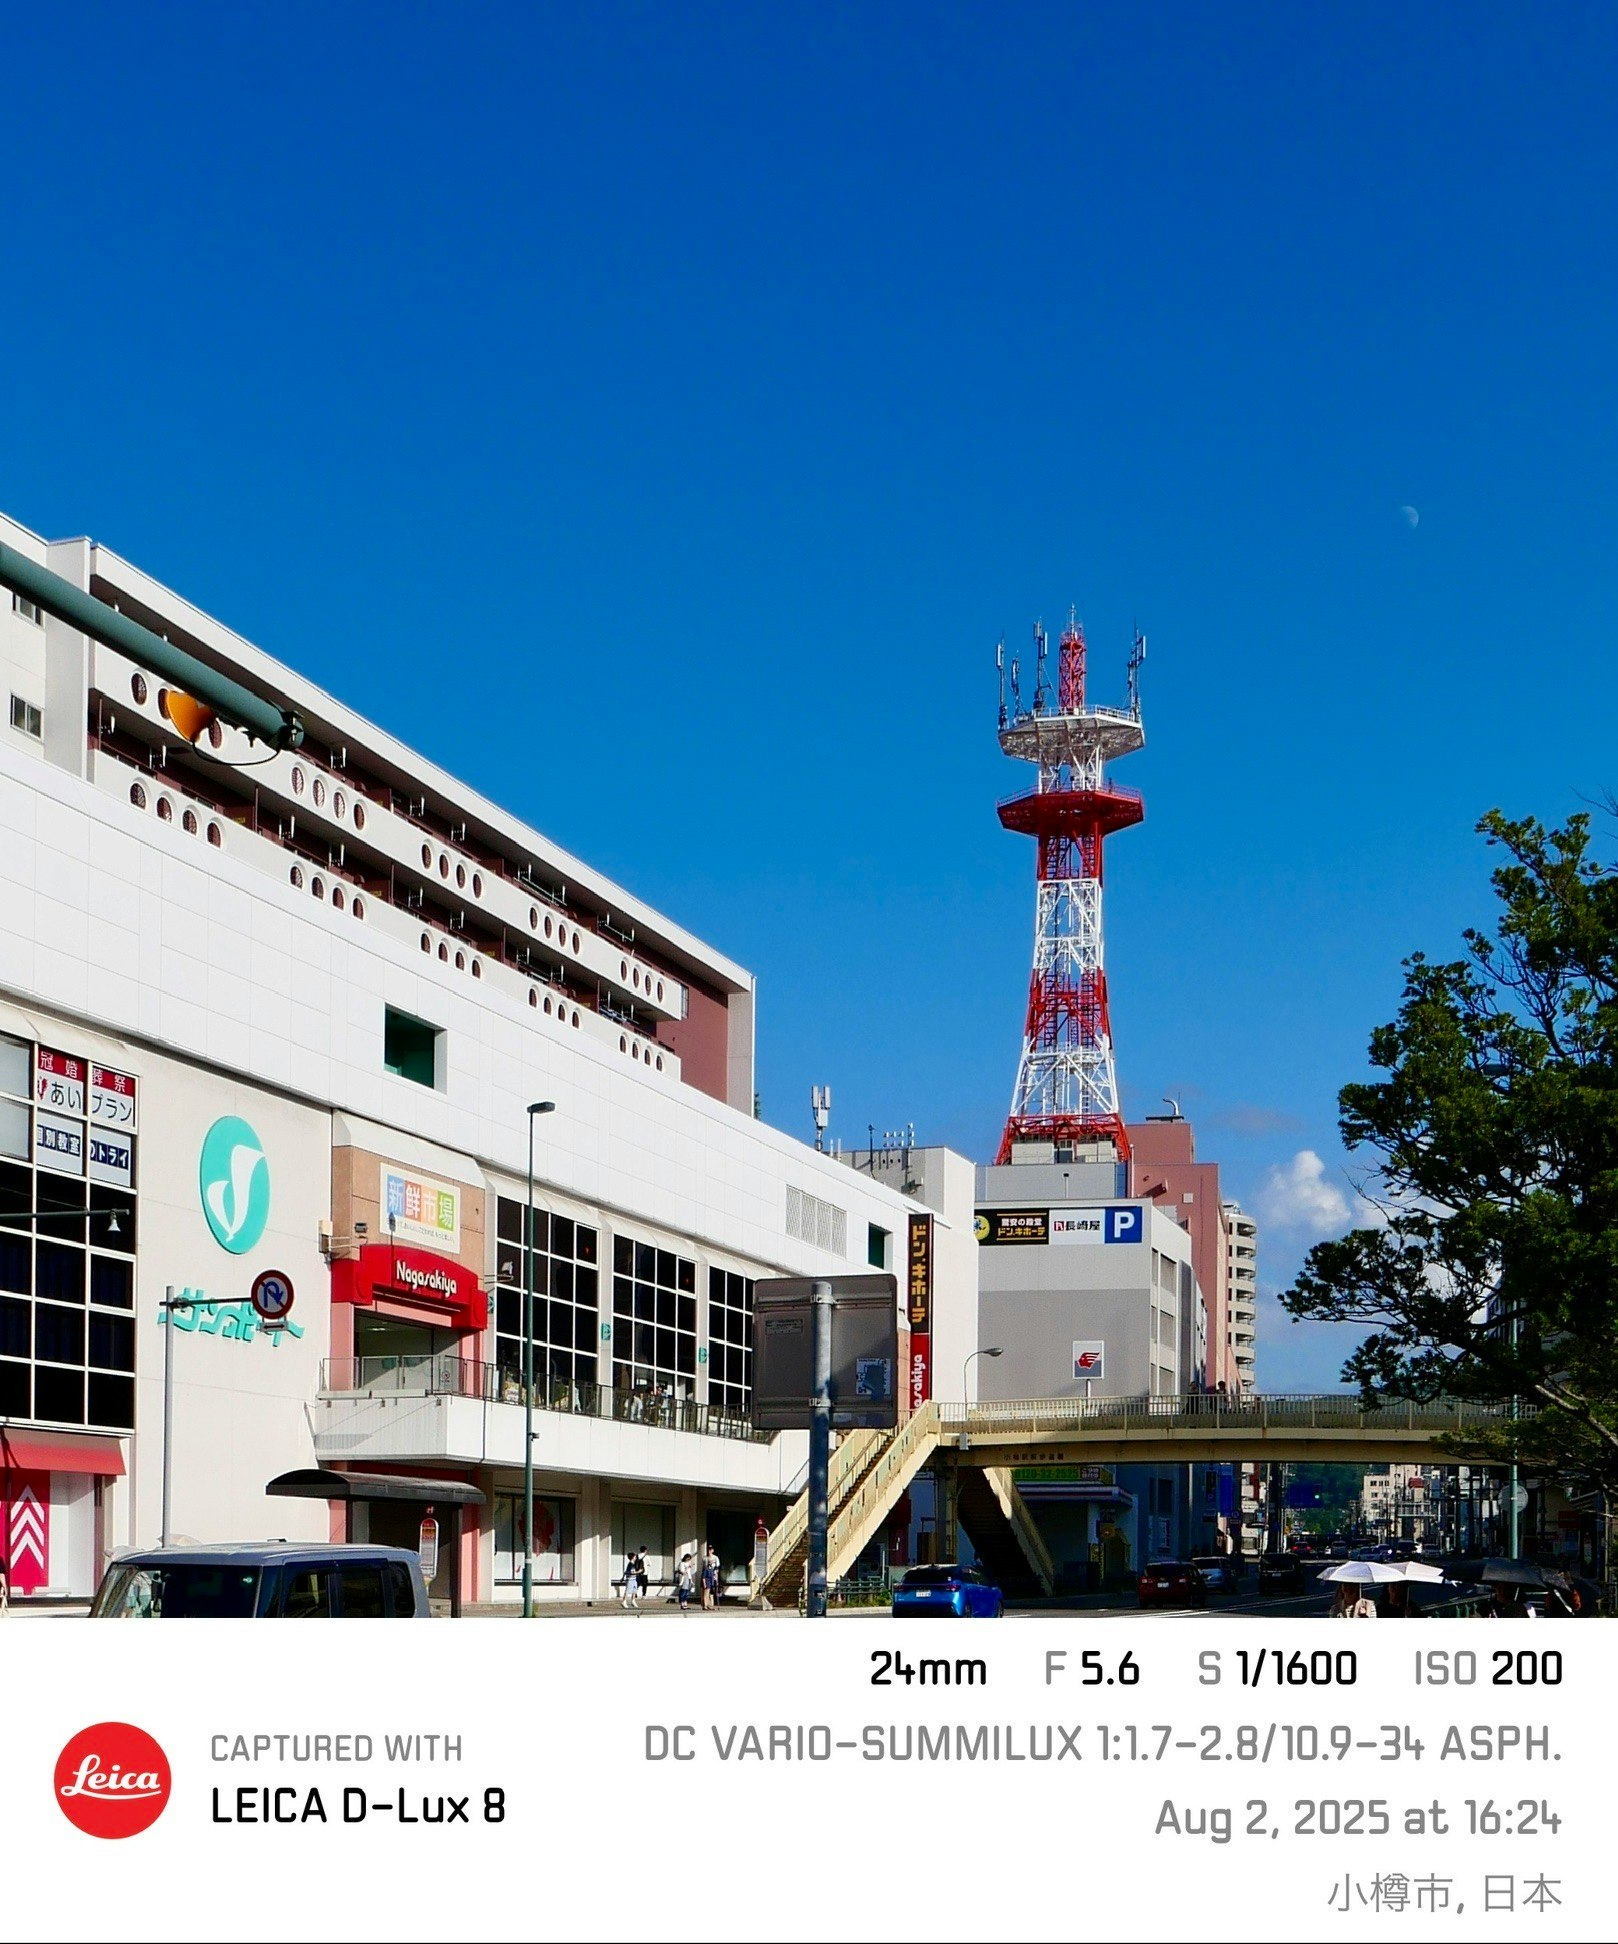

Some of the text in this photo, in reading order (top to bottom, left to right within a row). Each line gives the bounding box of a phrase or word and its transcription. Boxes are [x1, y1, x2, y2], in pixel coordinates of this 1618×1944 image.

[50, 1081, 132, 1122] あいプラン
[387, 1177, 455, 1228] 新鮮市場
[1065, 1220, 1101, 1231] 長崎屋
[1114, 1211, 1135, 1239] P
[396, 1260, 457, 1298] Nagasakiya
